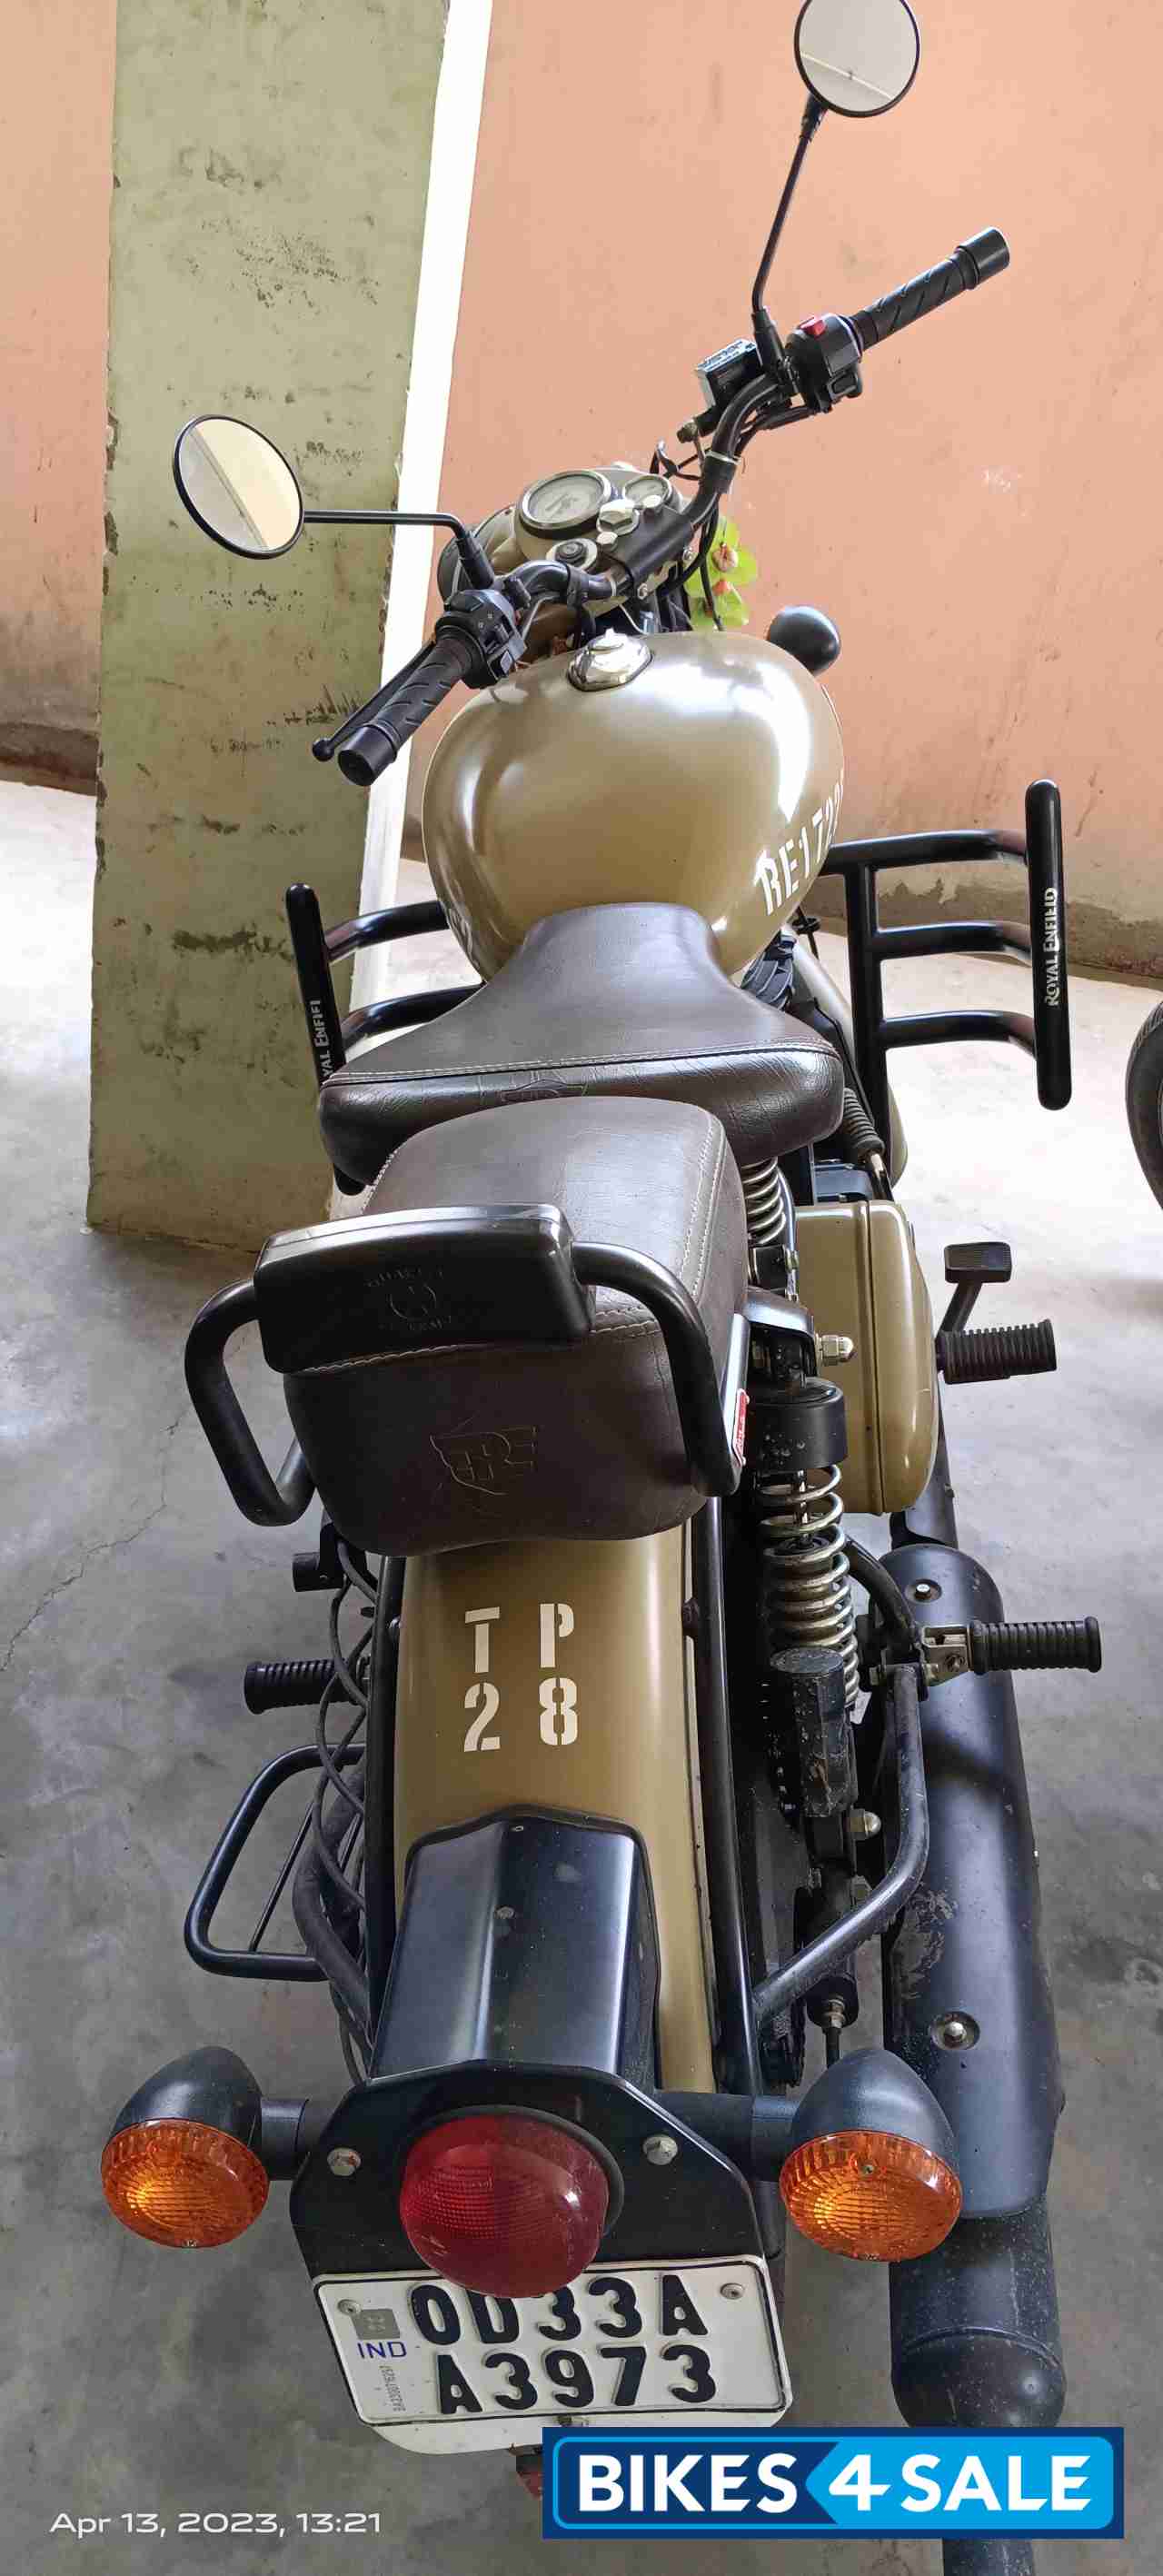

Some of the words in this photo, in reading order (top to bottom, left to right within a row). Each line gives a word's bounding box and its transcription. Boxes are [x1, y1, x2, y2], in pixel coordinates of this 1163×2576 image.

[1044, 955, 1060, 1007] ROYAL
[357, 2341, 407, 2359] IND
[437, 2344, 717, 2415] A3973
